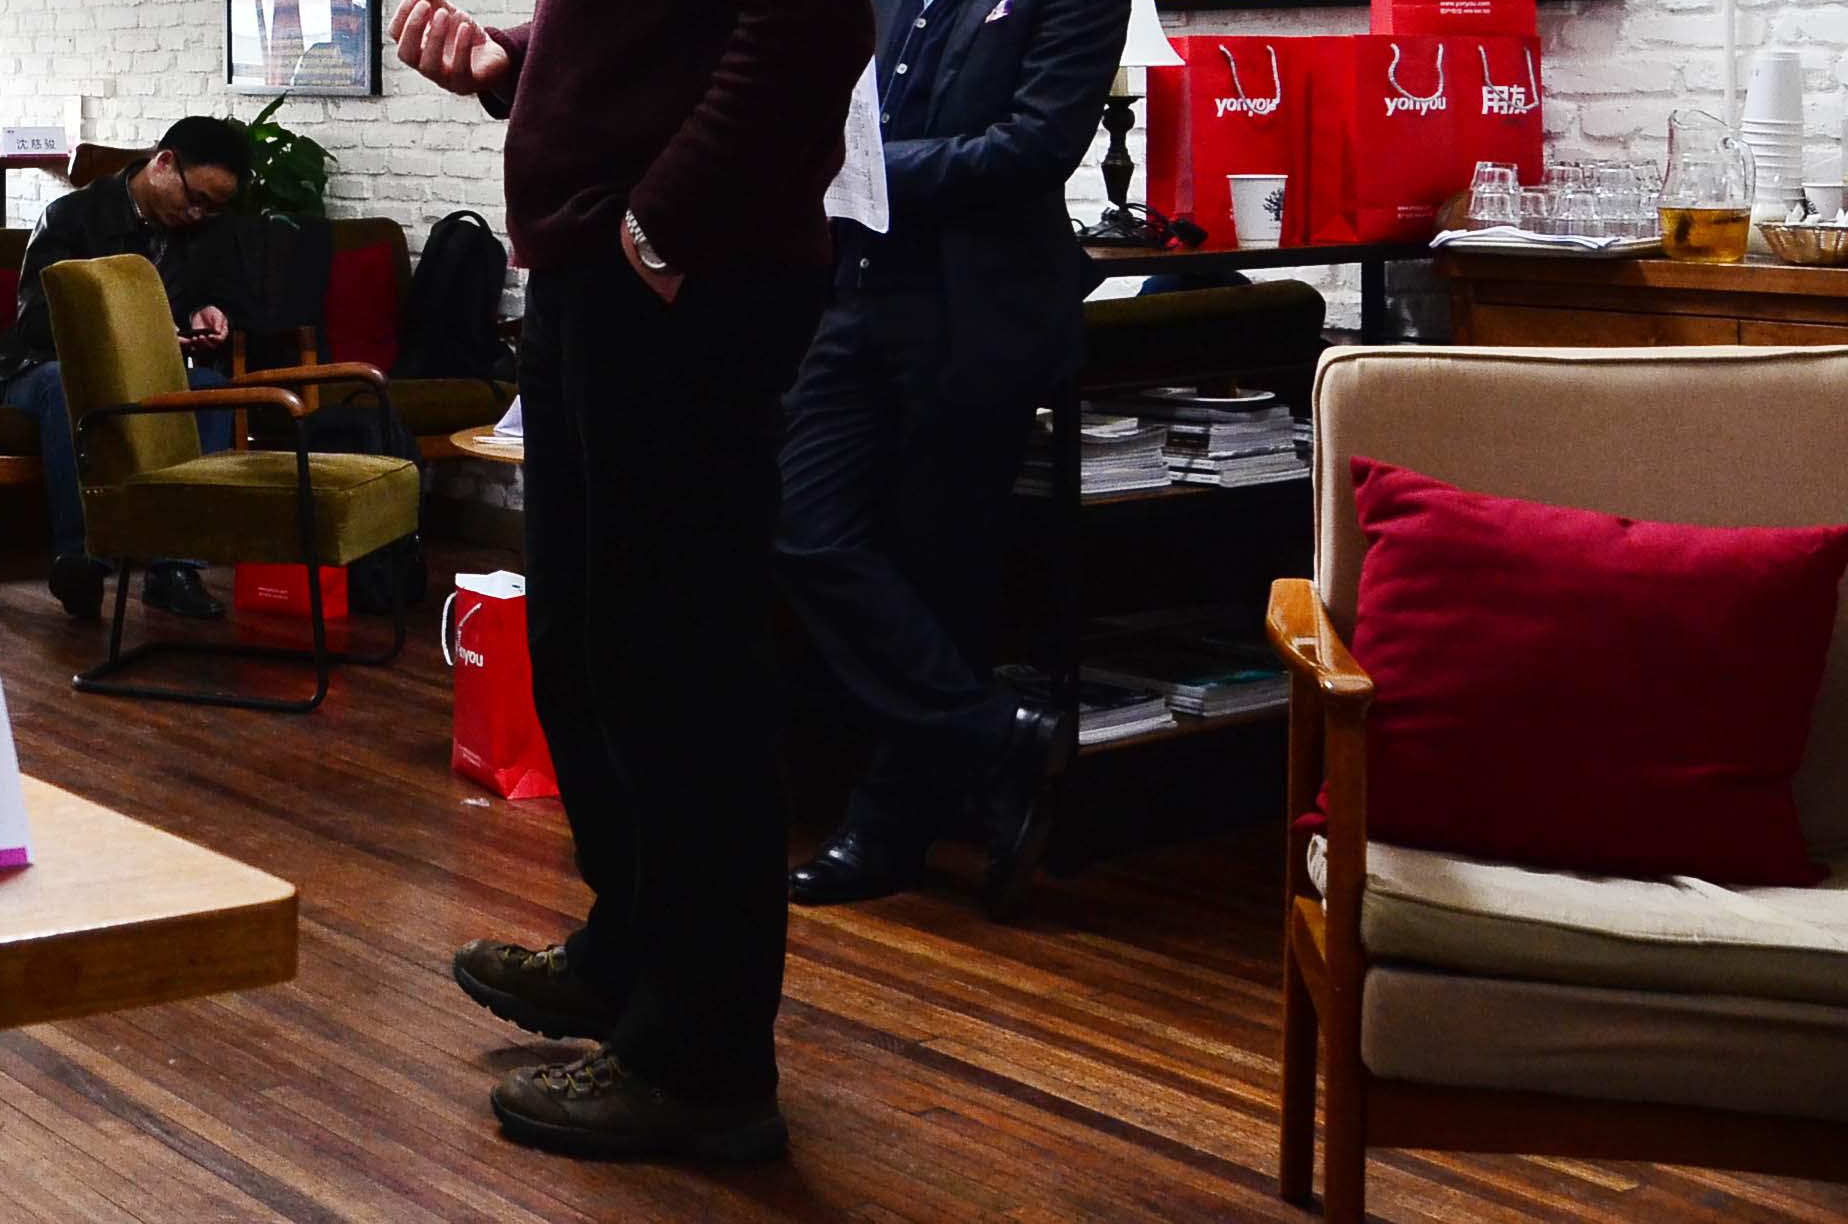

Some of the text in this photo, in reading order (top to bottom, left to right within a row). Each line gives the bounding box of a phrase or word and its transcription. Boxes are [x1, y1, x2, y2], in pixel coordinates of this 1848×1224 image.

[1214, 97, 1278, 118] yonyou
[1384, 96, 1447, 117] yonyou
[1481, 84, 1527, 115] 用友
